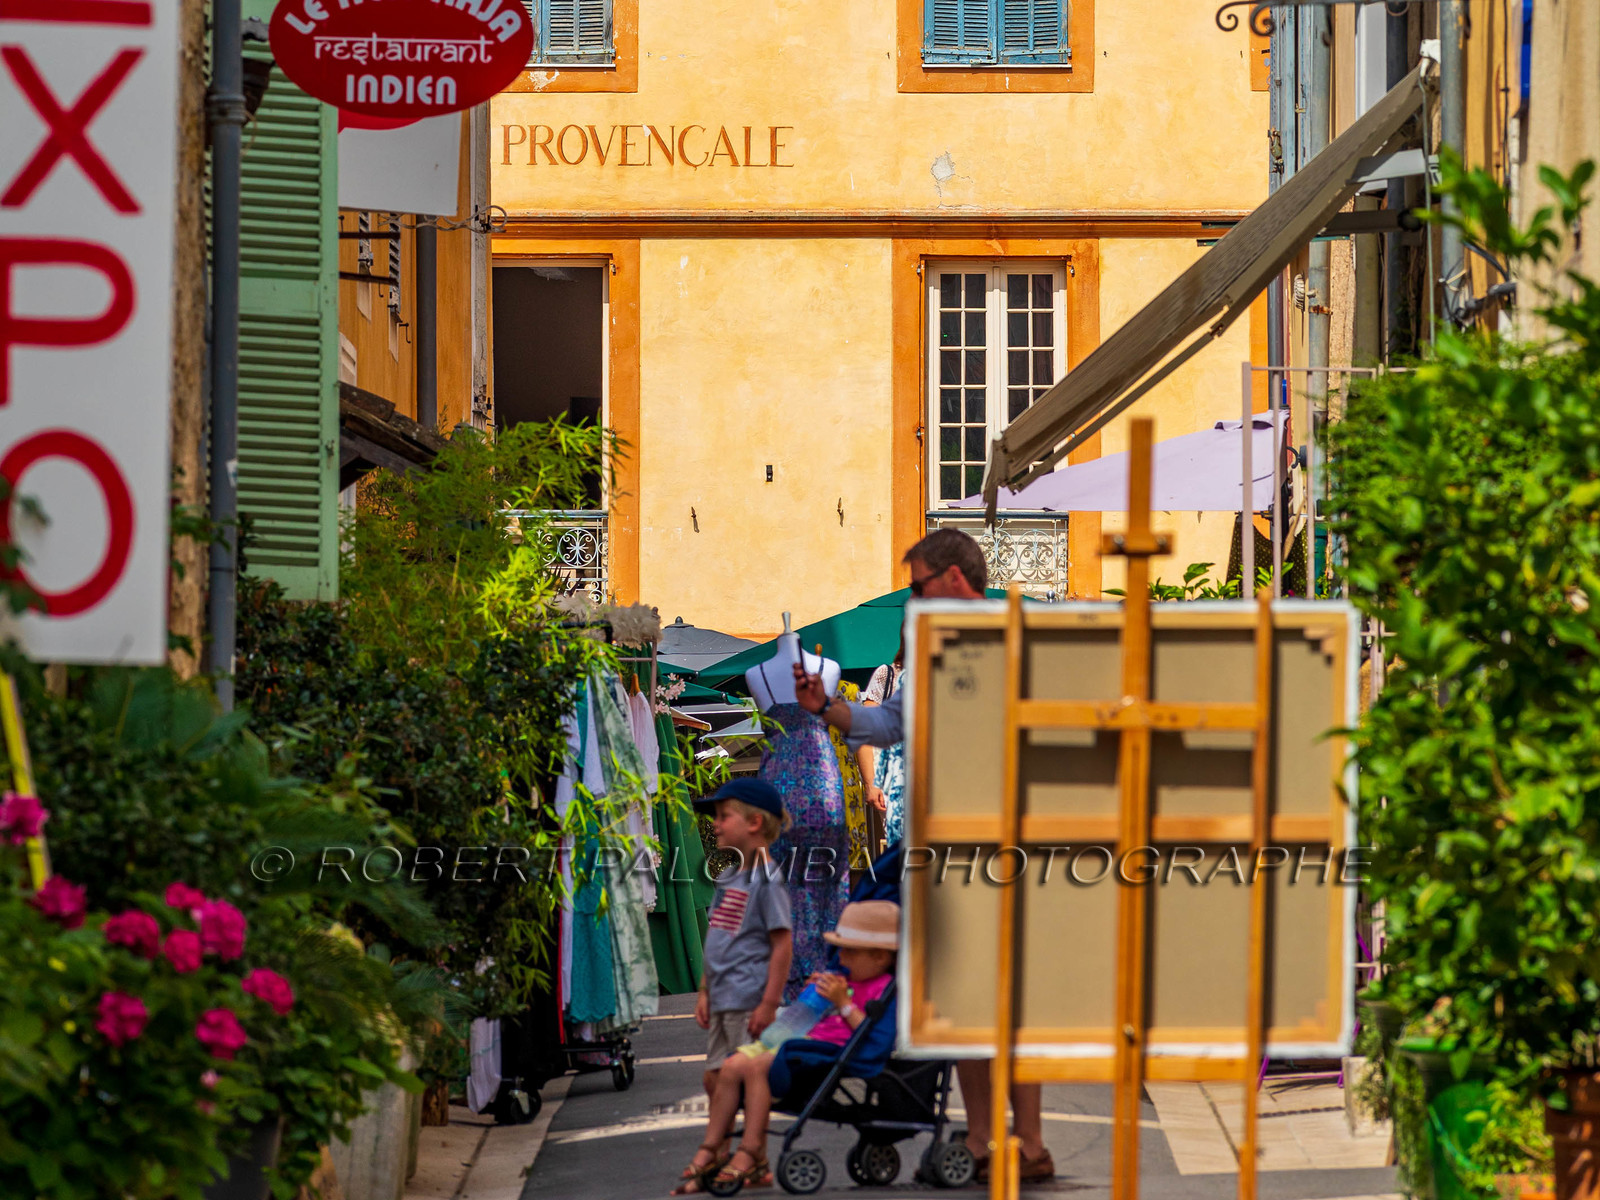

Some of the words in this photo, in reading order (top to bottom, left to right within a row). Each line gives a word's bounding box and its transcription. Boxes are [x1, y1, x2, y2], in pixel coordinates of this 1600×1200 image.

[313, 32, 494, 65] restaurant
[346, 74, 457, 105] INDIEN
[500, 124, 795, 171] PROVENÇALE
